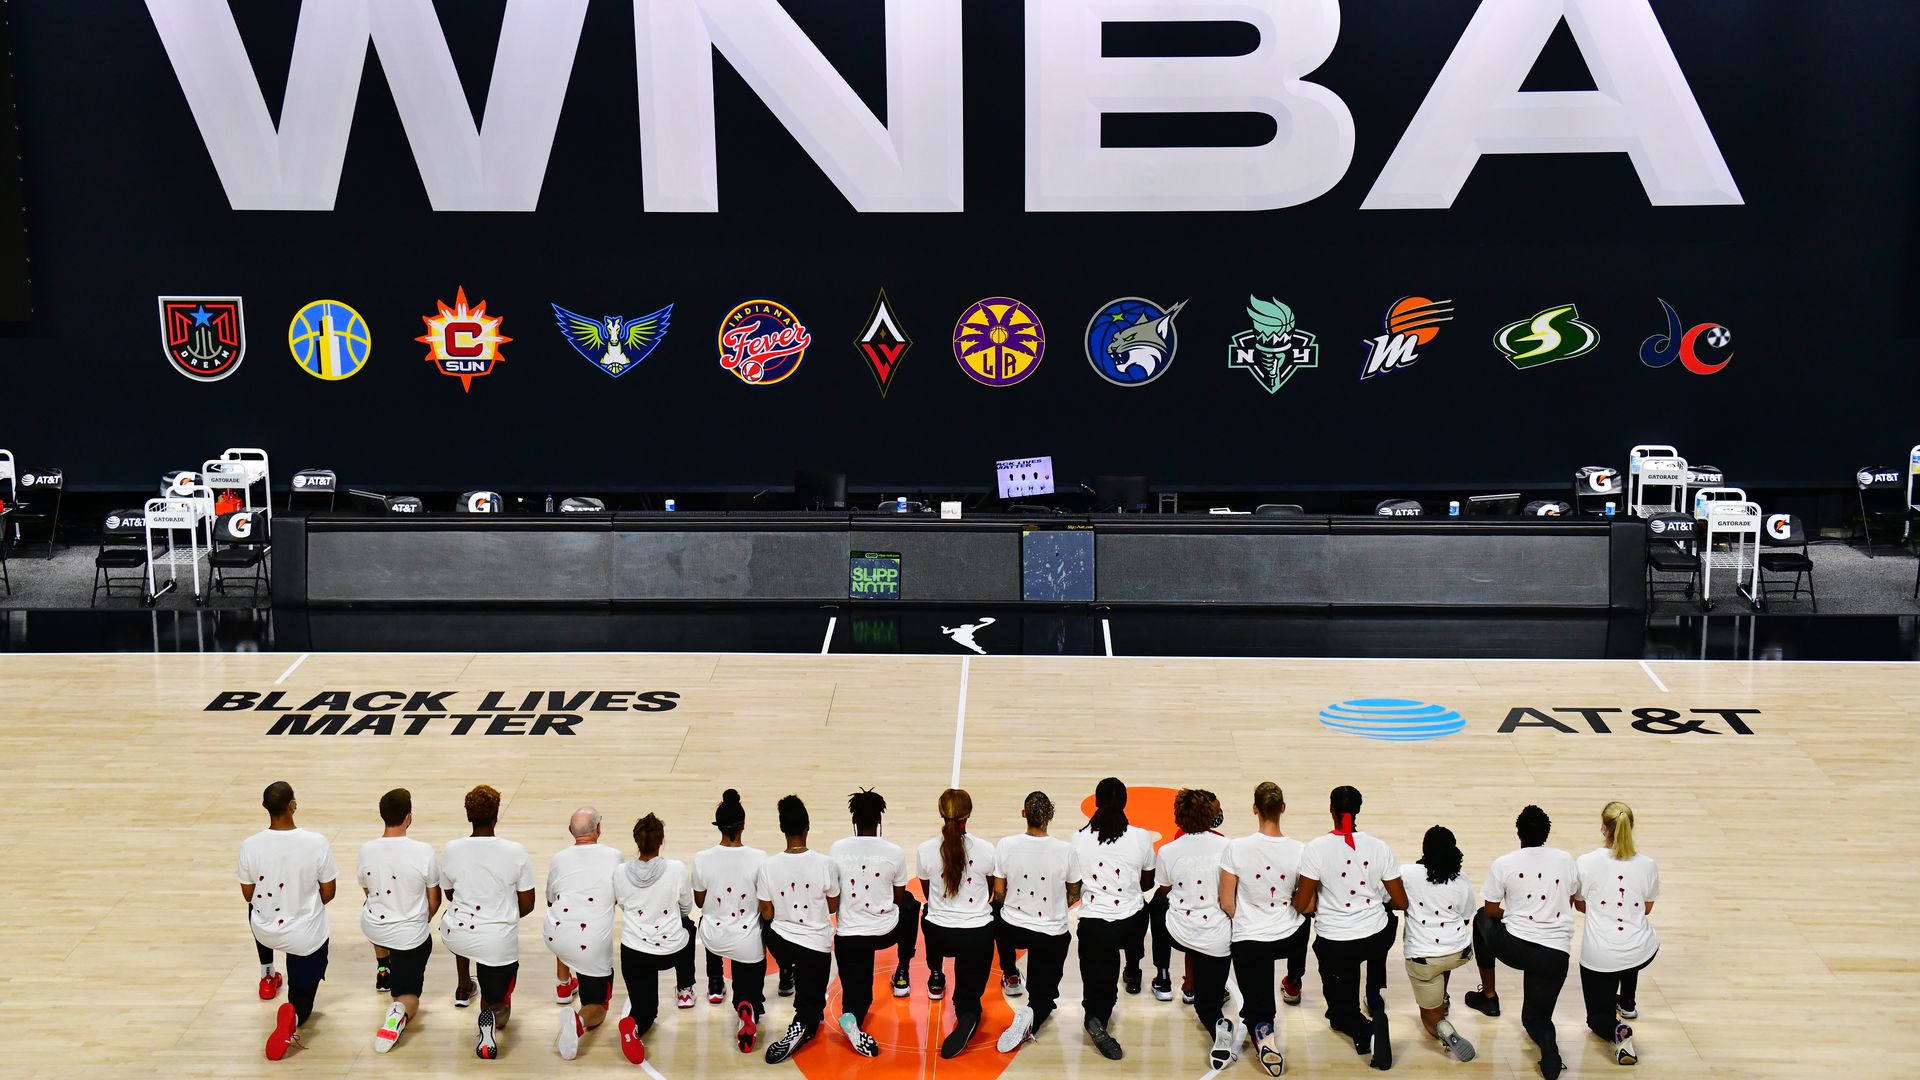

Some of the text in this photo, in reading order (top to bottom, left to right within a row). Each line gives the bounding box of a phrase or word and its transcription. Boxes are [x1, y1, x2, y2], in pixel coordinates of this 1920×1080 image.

[143, 0, 1744, 213] WNBA
[728, 305, 791, 328] INDIANA
[180, 350, 230, 369] DREAM
[445, 361, 485, 371] SUN
[35, 475, 61, 485] AT&T
[306, 476, 333, 486] AT&T
[1589, 470, 1613, 492] G
[1697, 473, 1723, 483] AT&T
[1874, 473, 1899, 483] AT&T
[227, 512, 253, 538] G
[1667, 521, 1694, 531] AT&T
[1766, 513, 1791, 540] G
[852, 567, 898, 582] SLIPP
[203, 690, 681, 712] BLACK LIVES
[265, 713, 585, 736] MATTER
[1496, 707, 1762, 735] AT&T
